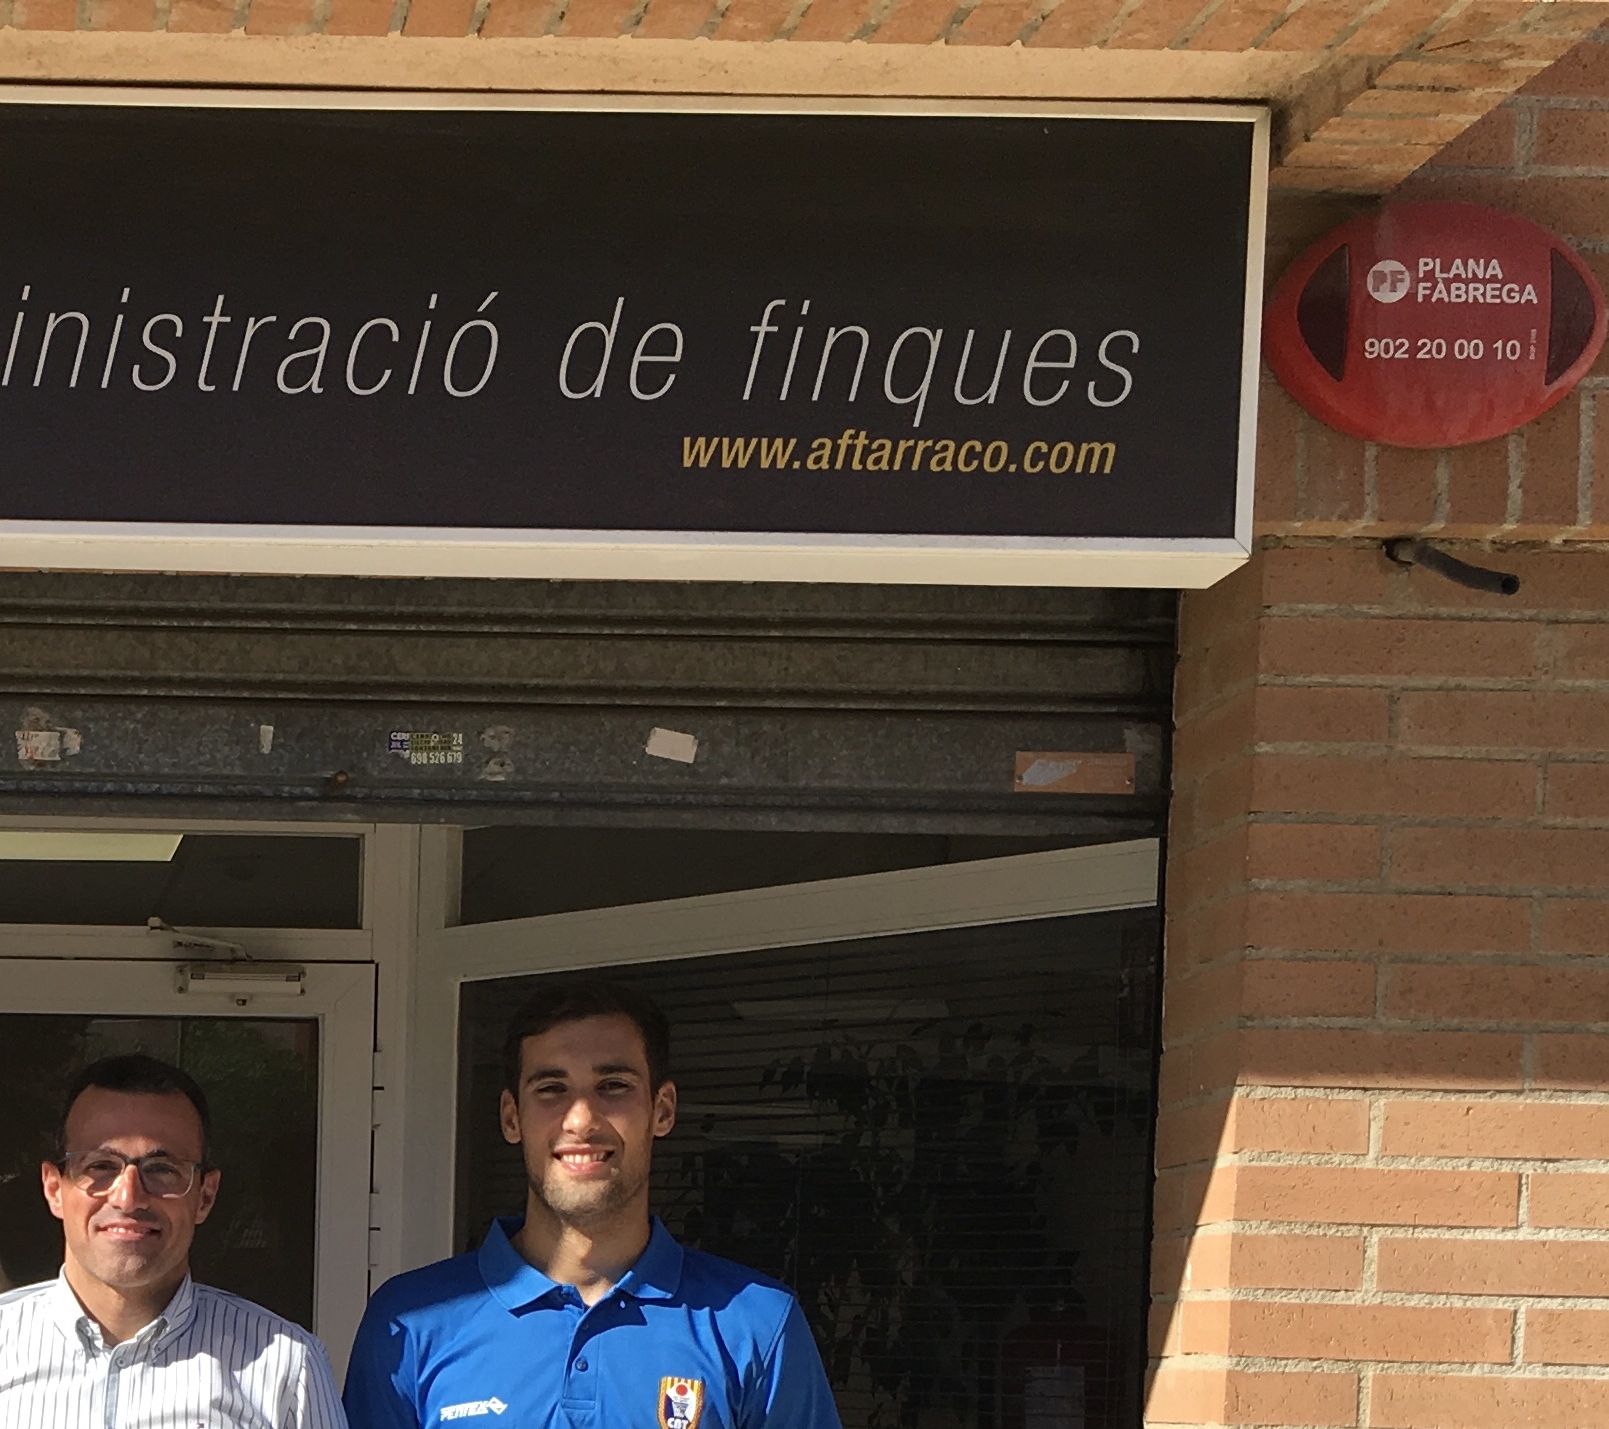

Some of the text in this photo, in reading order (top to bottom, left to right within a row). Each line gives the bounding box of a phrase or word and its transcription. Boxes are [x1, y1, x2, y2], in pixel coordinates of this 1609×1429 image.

[1418, 257, 1504, 280] PLANA
[1417, 277, 1538, 305] FÀBREGA
[558, 296, 685, 402] de
[741, 299, 1141, 428] finques
[1364, 338, 1410, 359] 902
[1416, 338, 1447, 359] 20
[1454, 338, 1484, 360] 00
[1492, 339, 1521, 361] 10
[681, 428, 1117, 475] www.aftarraco.com
